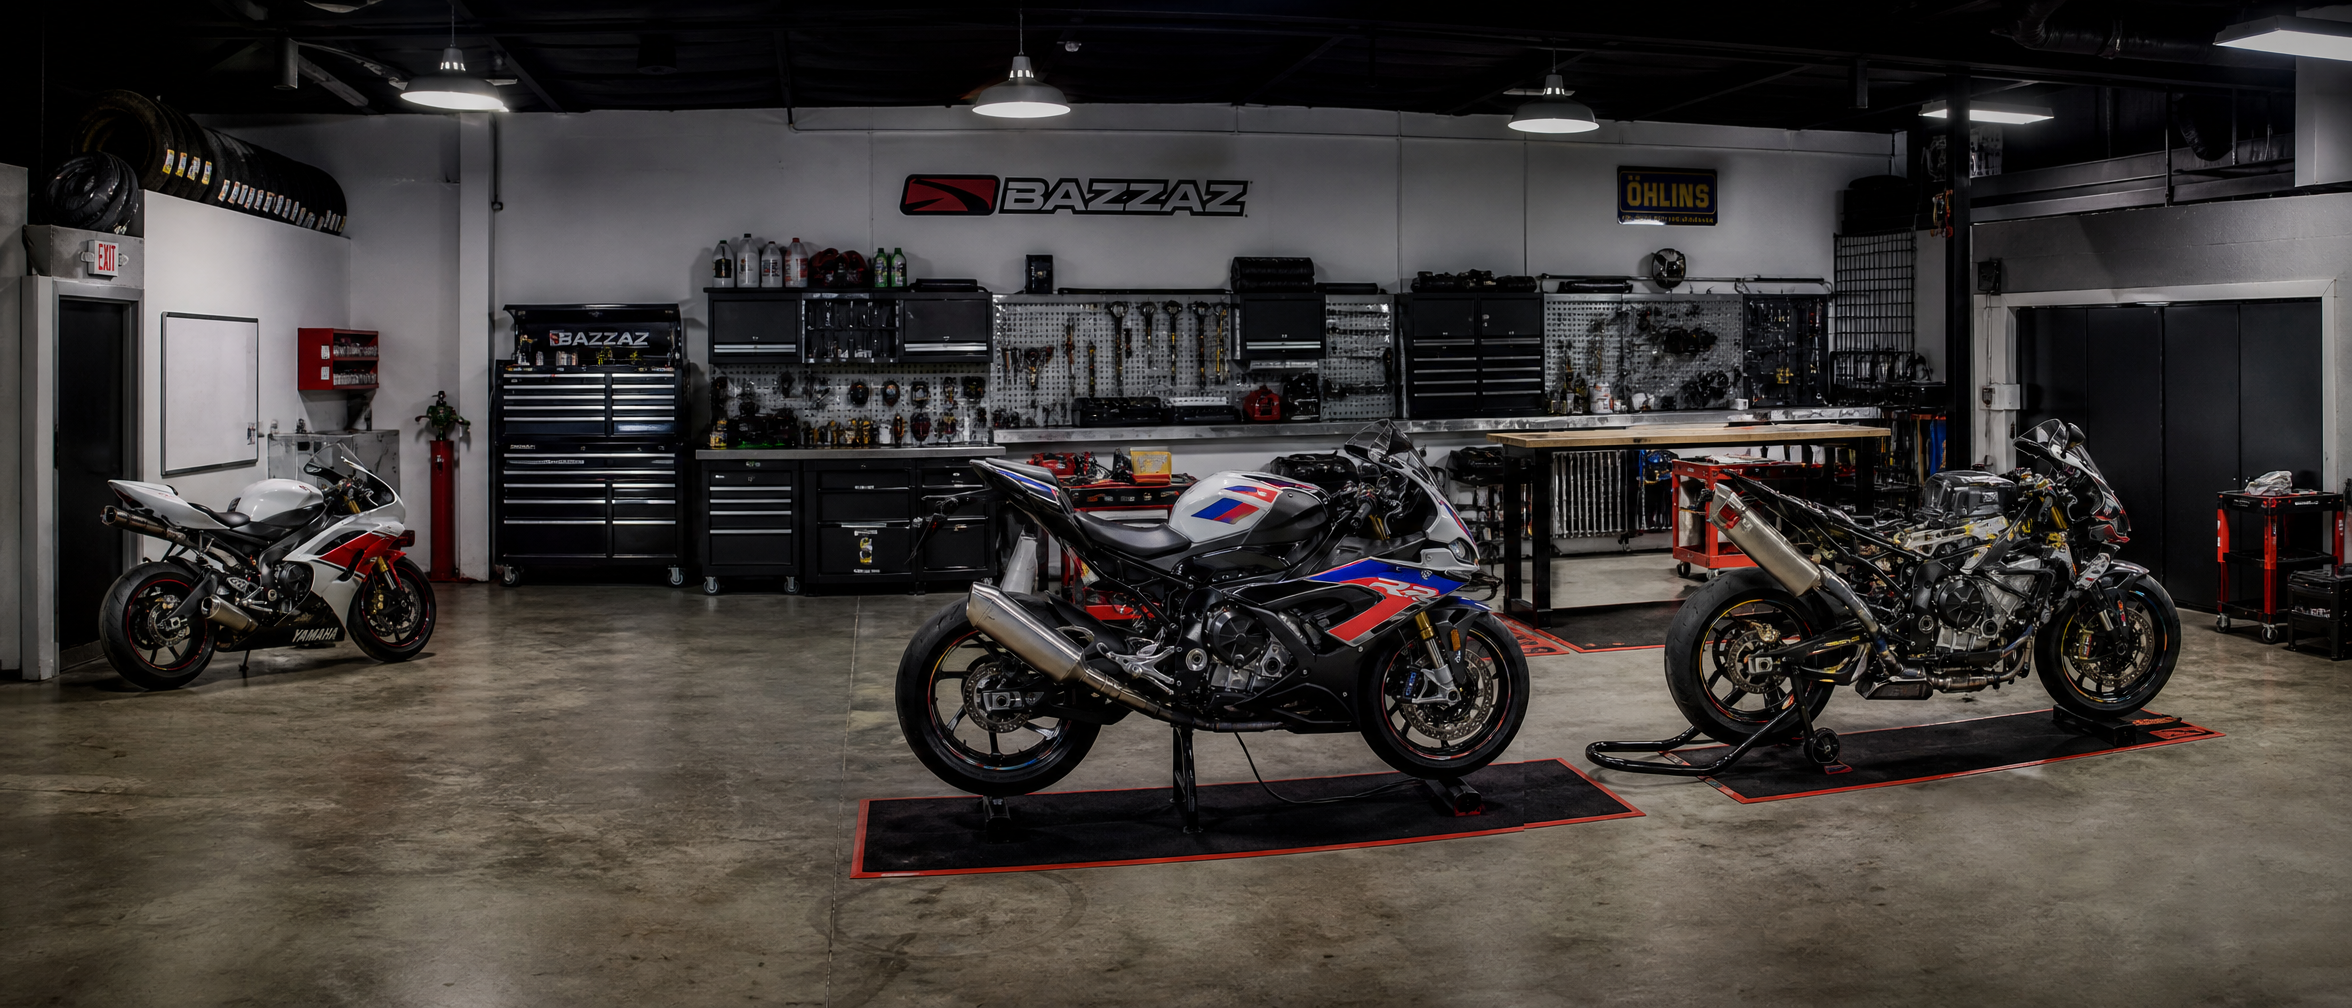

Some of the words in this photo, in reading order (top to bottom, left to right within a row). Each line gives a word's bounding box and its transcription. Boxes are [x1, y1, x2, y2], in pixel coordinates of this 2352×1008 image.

[1000, 177, 1248, 217] BAZZAZ
[1627, 175, 1710, 208] ÖHLINS
[98, 243, 116, 271] EXIT
[559, 331, 650, 346] BAZZAZ
[292, 627, 339, 643] YAMAHA
